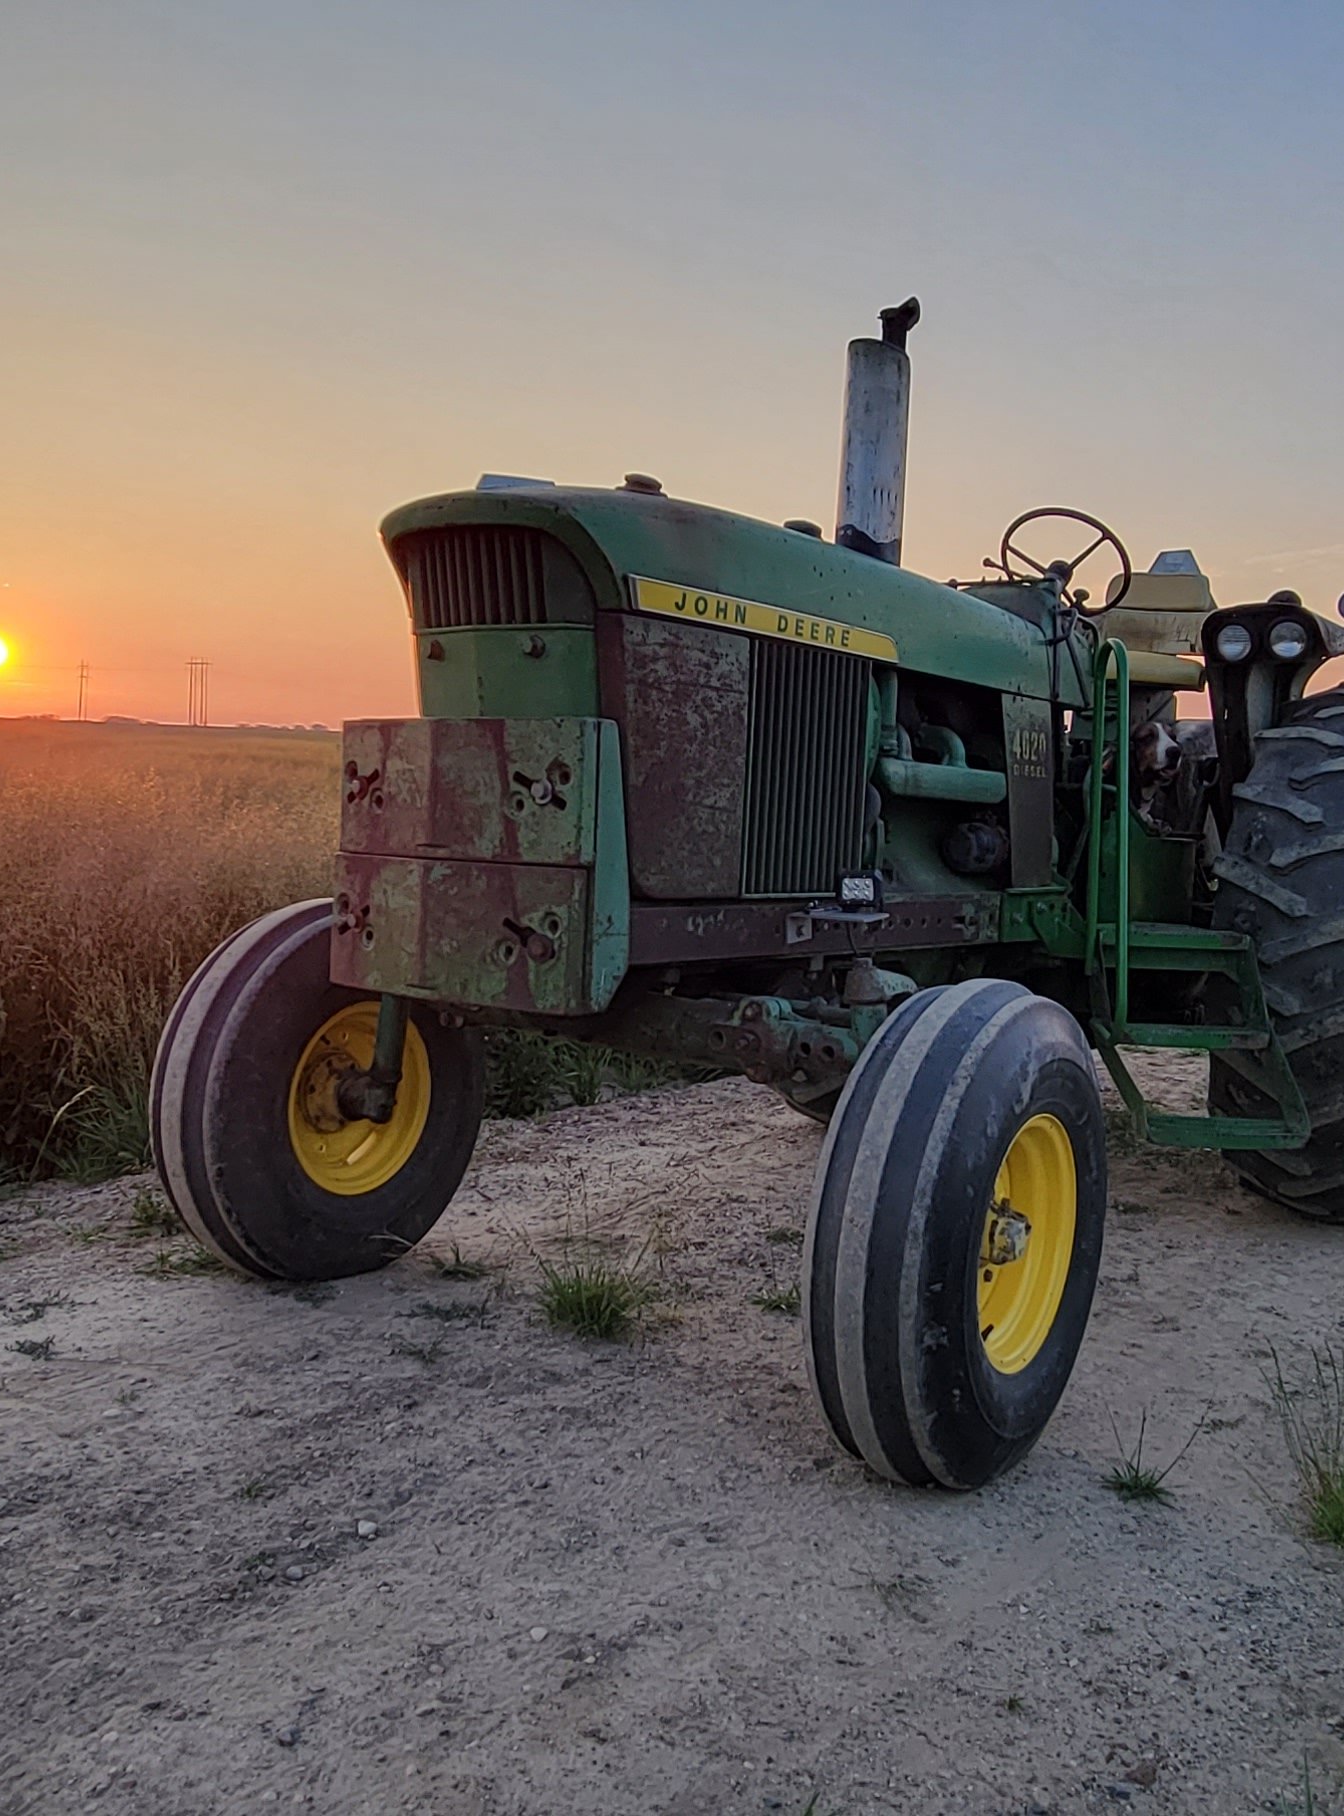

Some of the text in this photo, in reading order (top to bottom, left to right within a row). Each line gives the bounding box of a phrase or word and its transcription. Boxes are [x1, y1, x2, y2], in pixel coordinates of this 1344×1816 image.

[674, 592, 850, 647] JOHN DEERE
[1013, 729, 1047, 760] 4020
[1014, 764, 1047, 778] DIESEL
